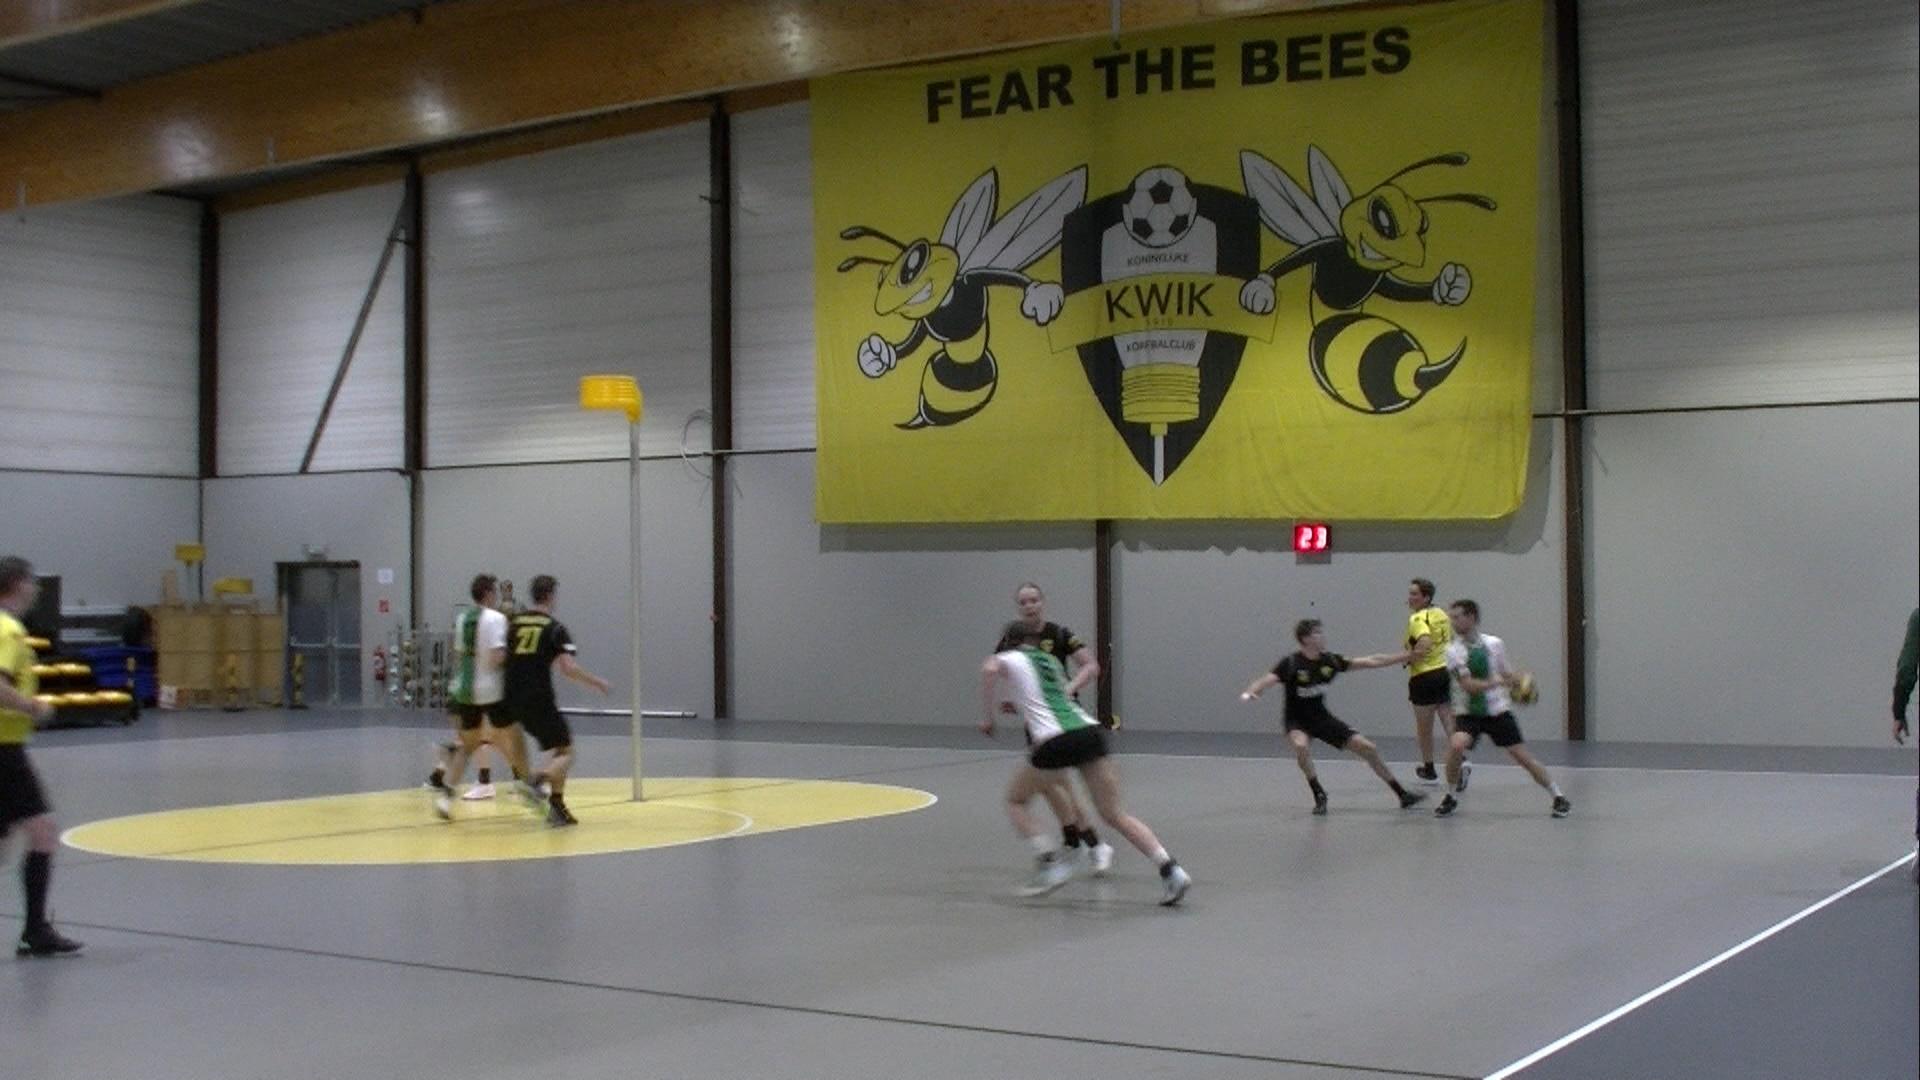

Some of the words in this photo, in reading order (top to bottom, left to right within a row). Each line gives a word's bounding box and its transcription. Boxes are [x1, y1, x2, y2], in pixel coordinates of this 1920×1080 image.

[926, 63, 1074, 124] FEAR
[1094, 43, 1216, 99] THE
[1240, 26, 1412, 86] BEES
[1105, 282, 1215, 322] KWIK
[1299, 526, 1327, 550] 23
